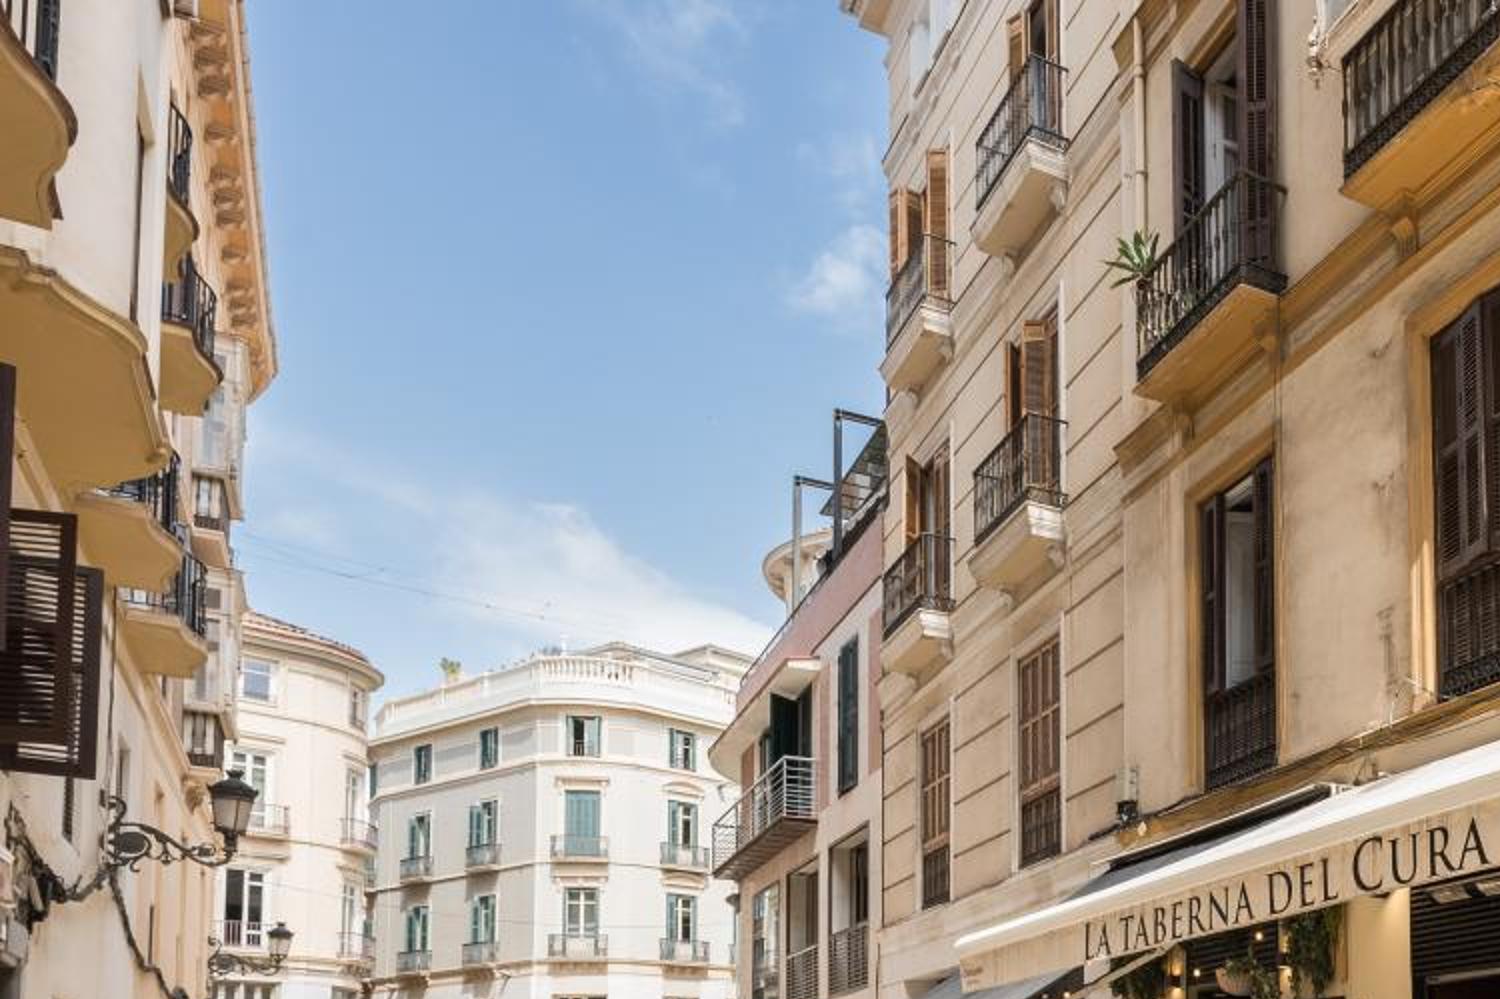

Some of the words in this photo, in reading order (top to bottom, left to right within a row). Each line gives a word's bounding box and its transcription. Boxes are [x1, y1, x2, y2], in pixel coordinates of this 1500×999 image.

[1084, 921, 1112, 961] LA
[1120, 879, 1254, 951] TABERNA
[1265, 857, 1339, 916] DEL
[1352, 817, 1490, 893] CURA
